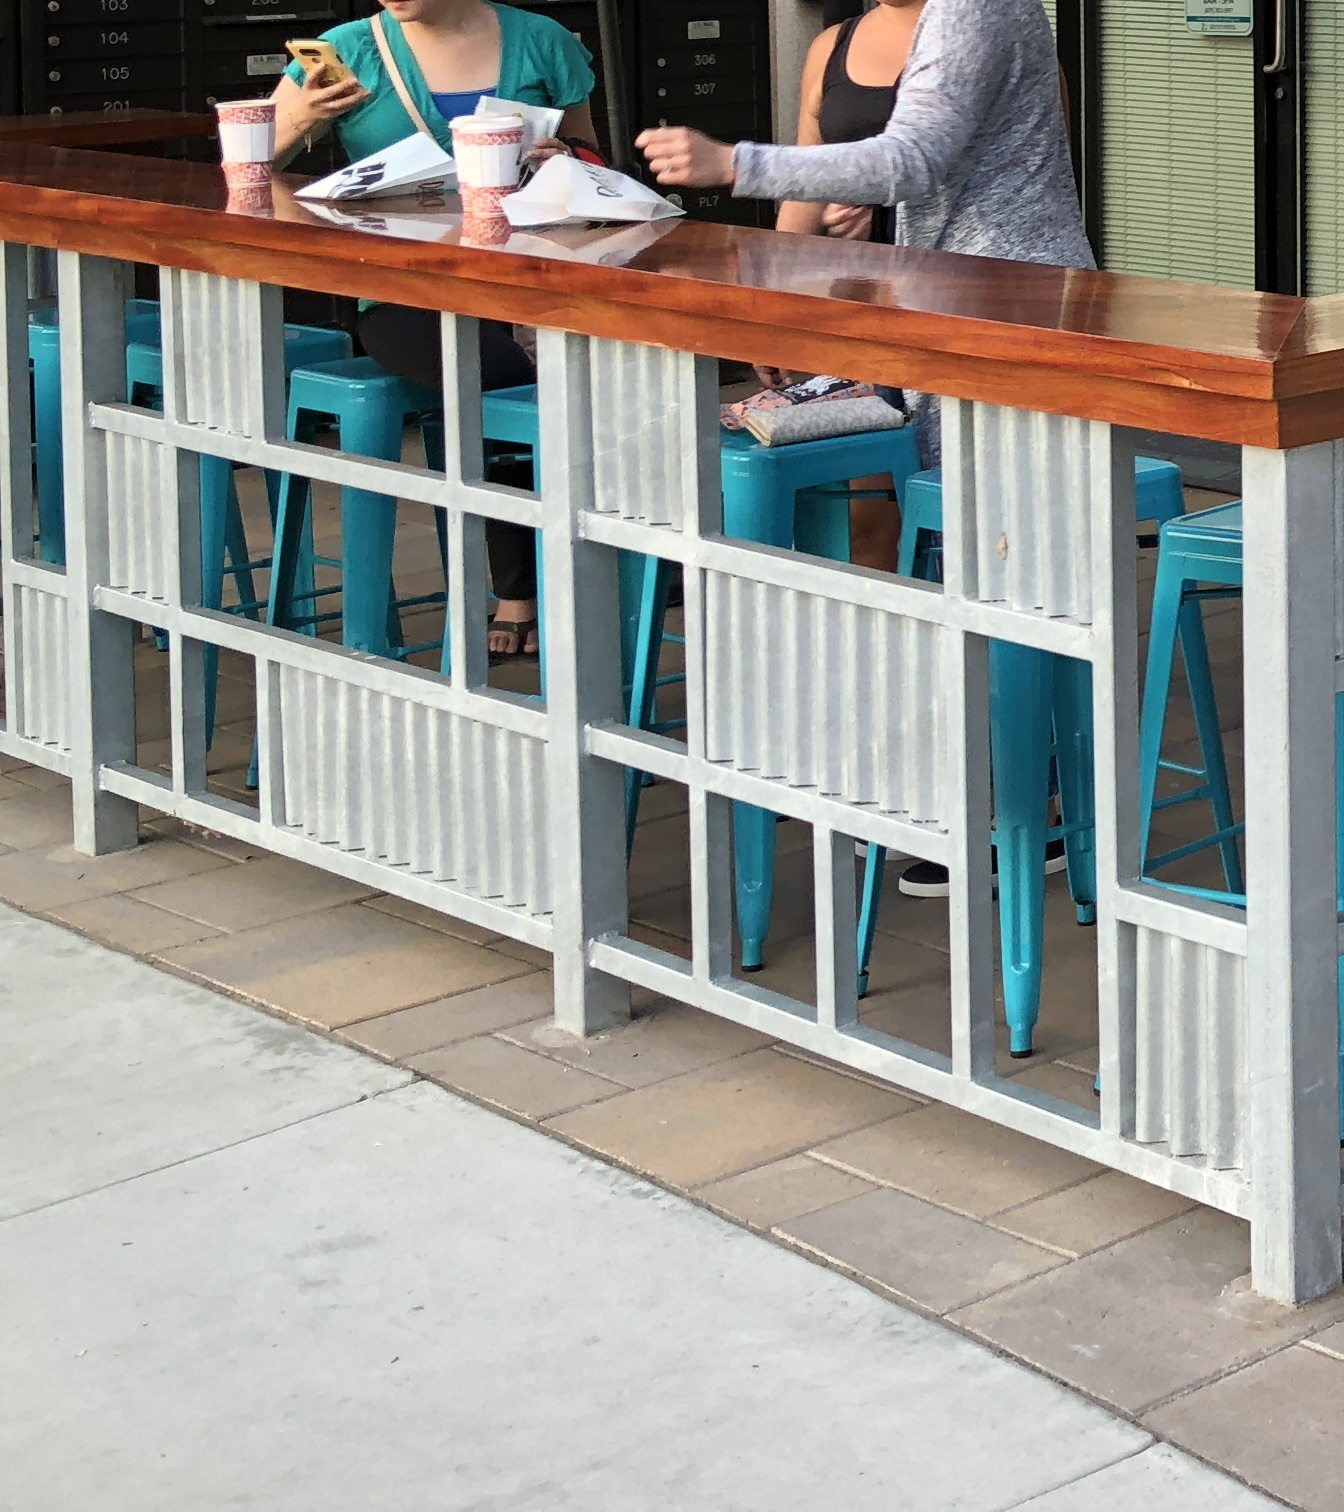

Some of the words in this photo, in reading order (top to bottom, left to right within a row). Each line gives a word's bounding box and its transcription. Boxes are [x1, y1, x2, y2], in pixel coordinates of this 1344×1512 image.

[100, 31, 129, 45] 104
[694, 53, 716, 66] 306
[102, 66, 130, 81] 105
[694, 82, 716, 96] 307
[698, 195, 720, 207] PL7
